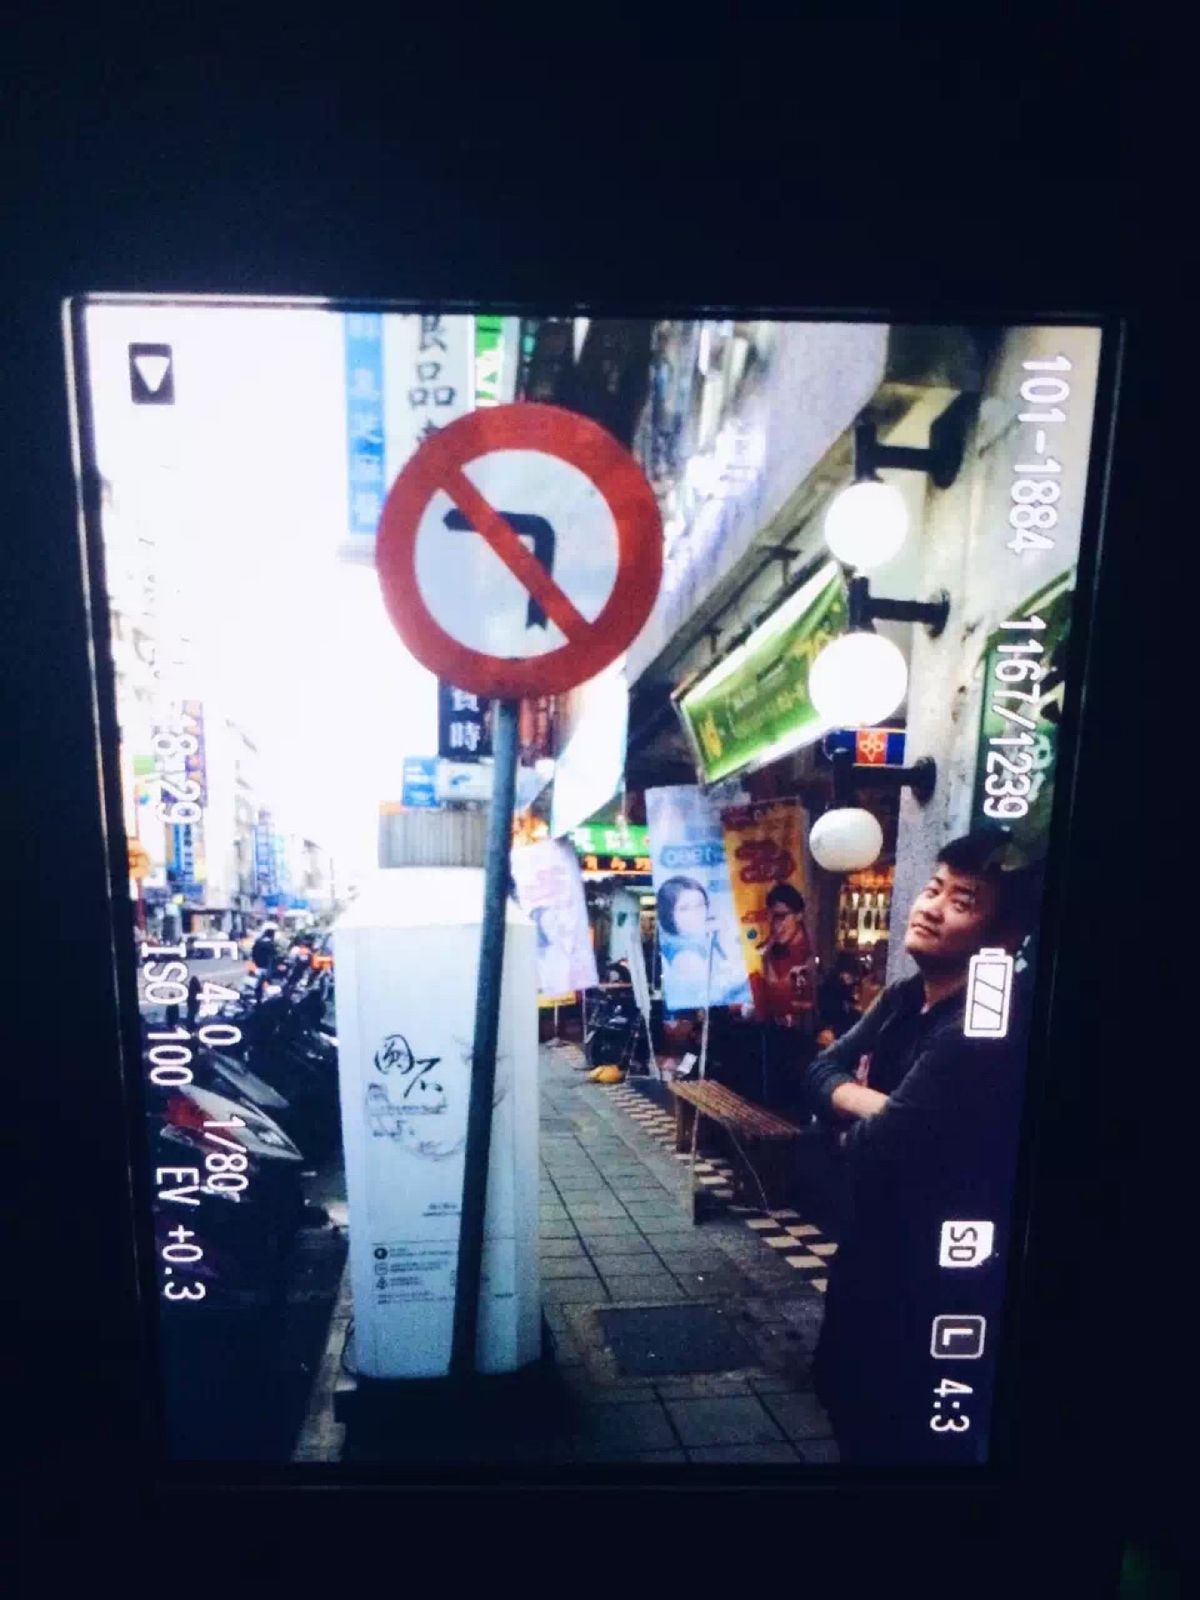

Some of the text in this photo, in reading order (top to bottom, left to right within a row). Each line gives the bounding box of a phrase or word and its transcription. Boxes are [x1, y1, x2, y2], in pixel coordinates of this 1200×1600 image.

[1007, 354, 1073, 555] 101-1884
[141, 941, 190, 1005] ISO
[192, 940, 239, 961] F
[147, 1027, 193, 1087] 100
[203, 1113, 249, 1193] 1/80
[155, 1165, 201, 1207] EV
[164, 1230, 207, 1302] +0.3
[948, 1226, 978, 1262] SD
[930, 1378, 972, 1432] 4:3
